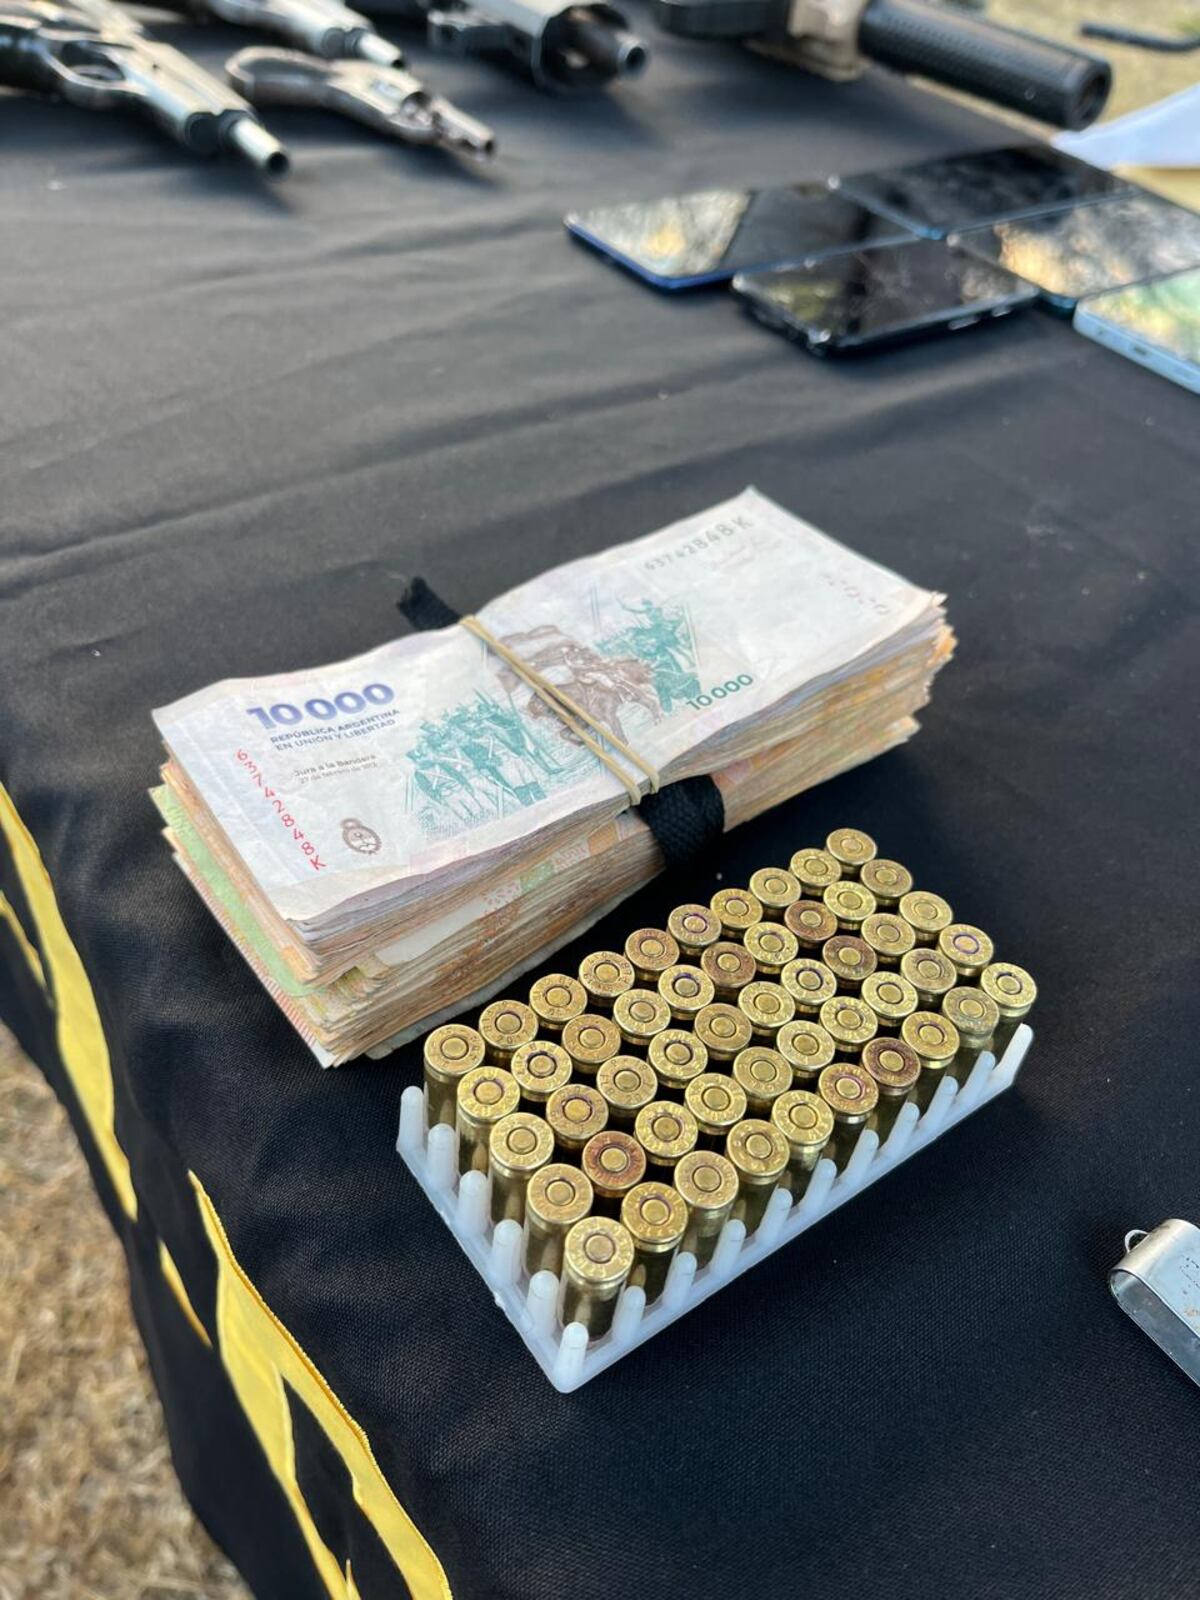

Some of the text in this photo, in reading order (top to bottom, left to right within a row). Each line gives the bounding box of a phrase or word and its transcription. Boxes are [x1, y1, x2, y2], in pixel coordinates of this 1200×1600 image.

[270, 709, 400, 743] REPÚBLICA ARGENTINA
[275, 742, 293, 751] EN
[333, 731, 342, 741] Y
[343, 719, 396, 739] LIBERTAD
[237, 749, 327, 871] 63742848K
